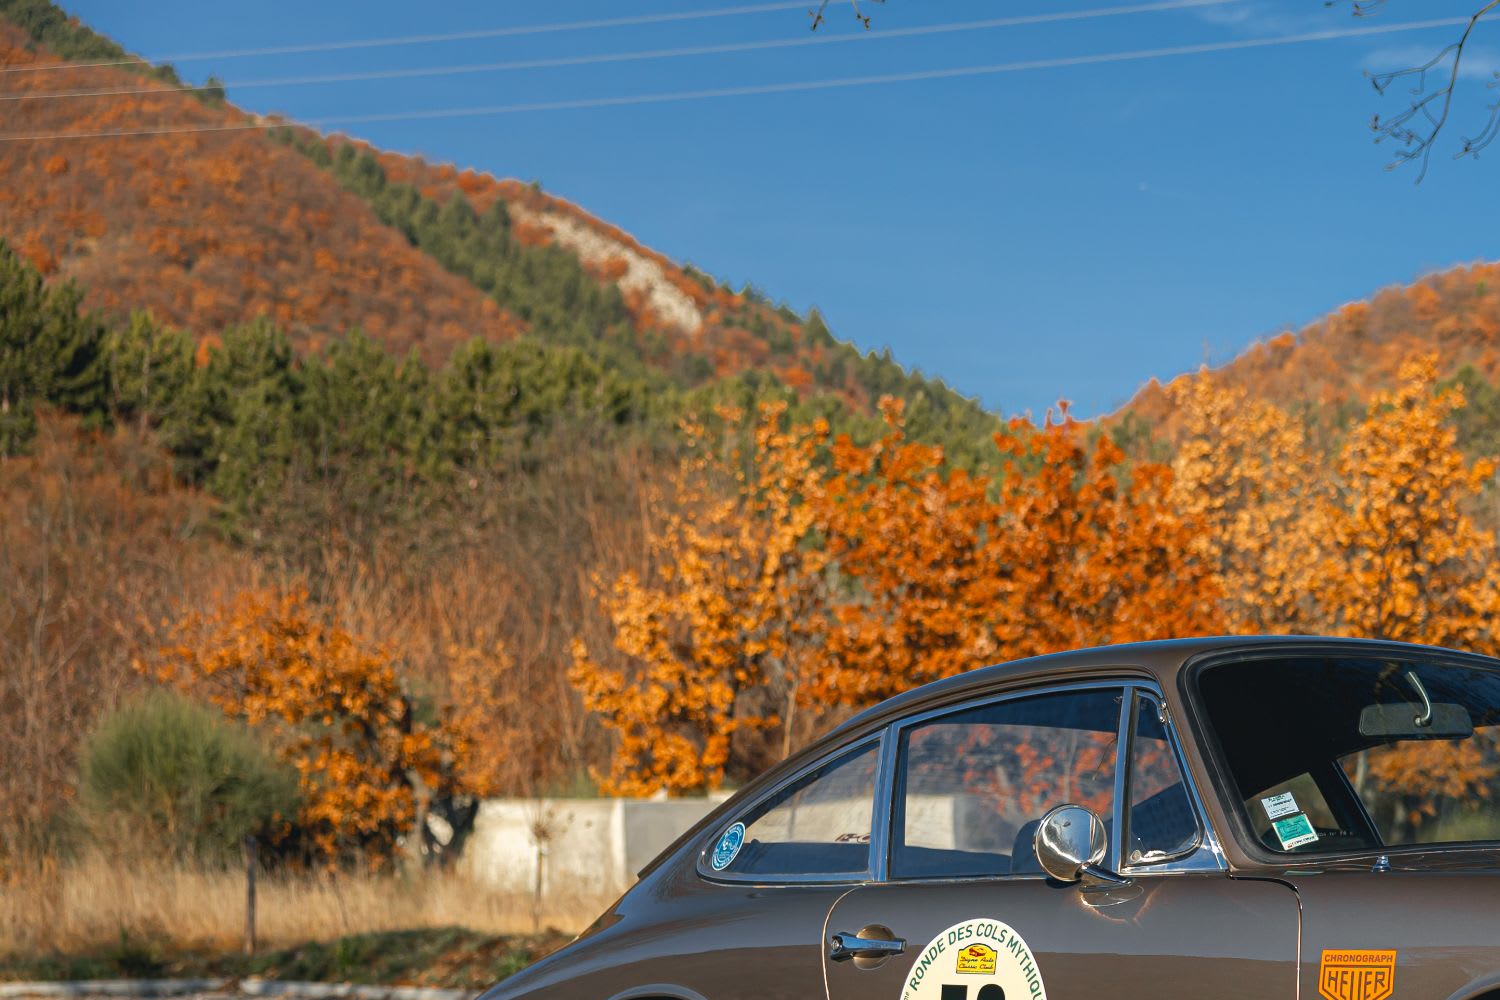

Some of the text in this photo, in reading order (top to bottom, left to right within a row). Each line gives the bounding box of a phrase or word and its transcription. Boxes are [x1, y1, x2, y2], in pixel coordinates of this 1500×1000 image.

[909, 938, 946, 991] RONDE
[948, 924, 973, 945] DES
[976, 923, 1008, 943] COLS
[1324, 954, 1393, 963] CHRONOGRAPH
